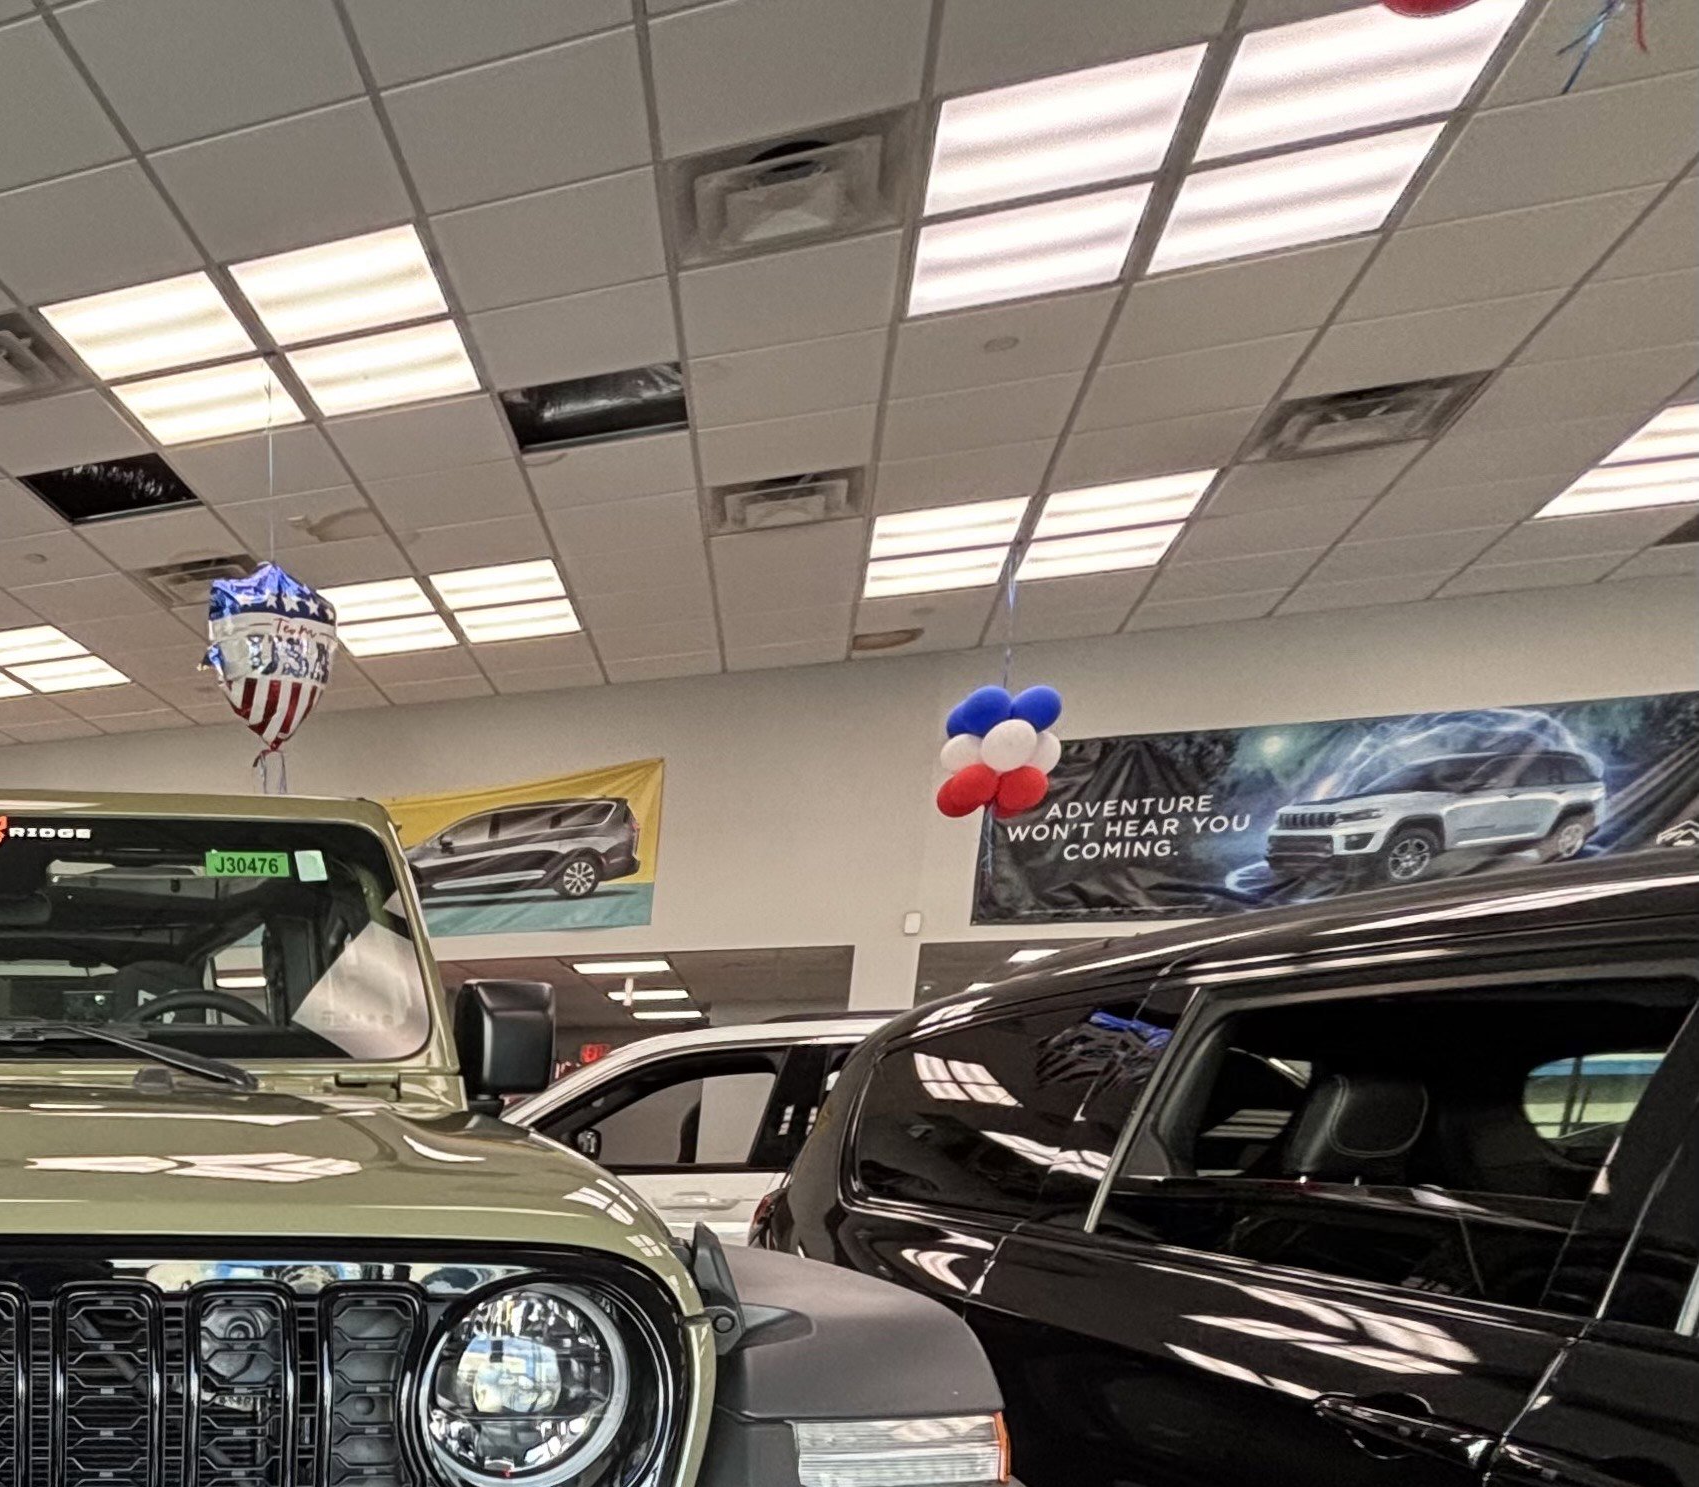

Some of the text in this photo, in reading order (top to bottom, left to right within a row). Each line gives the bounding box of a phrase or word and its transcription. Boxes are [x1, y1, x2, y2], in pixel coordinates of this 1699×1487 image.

[247, 633, 330, 684] USA
[1045, 794, 1214, 820] ADVENTURE
[8, 827, 91, 838] RIDGE
[1007, 814, 1251, 842] WON'T HEAR YOU
[1063, 839, 1179, 861] COMING.
[215, 856, 279, 874] J30476
